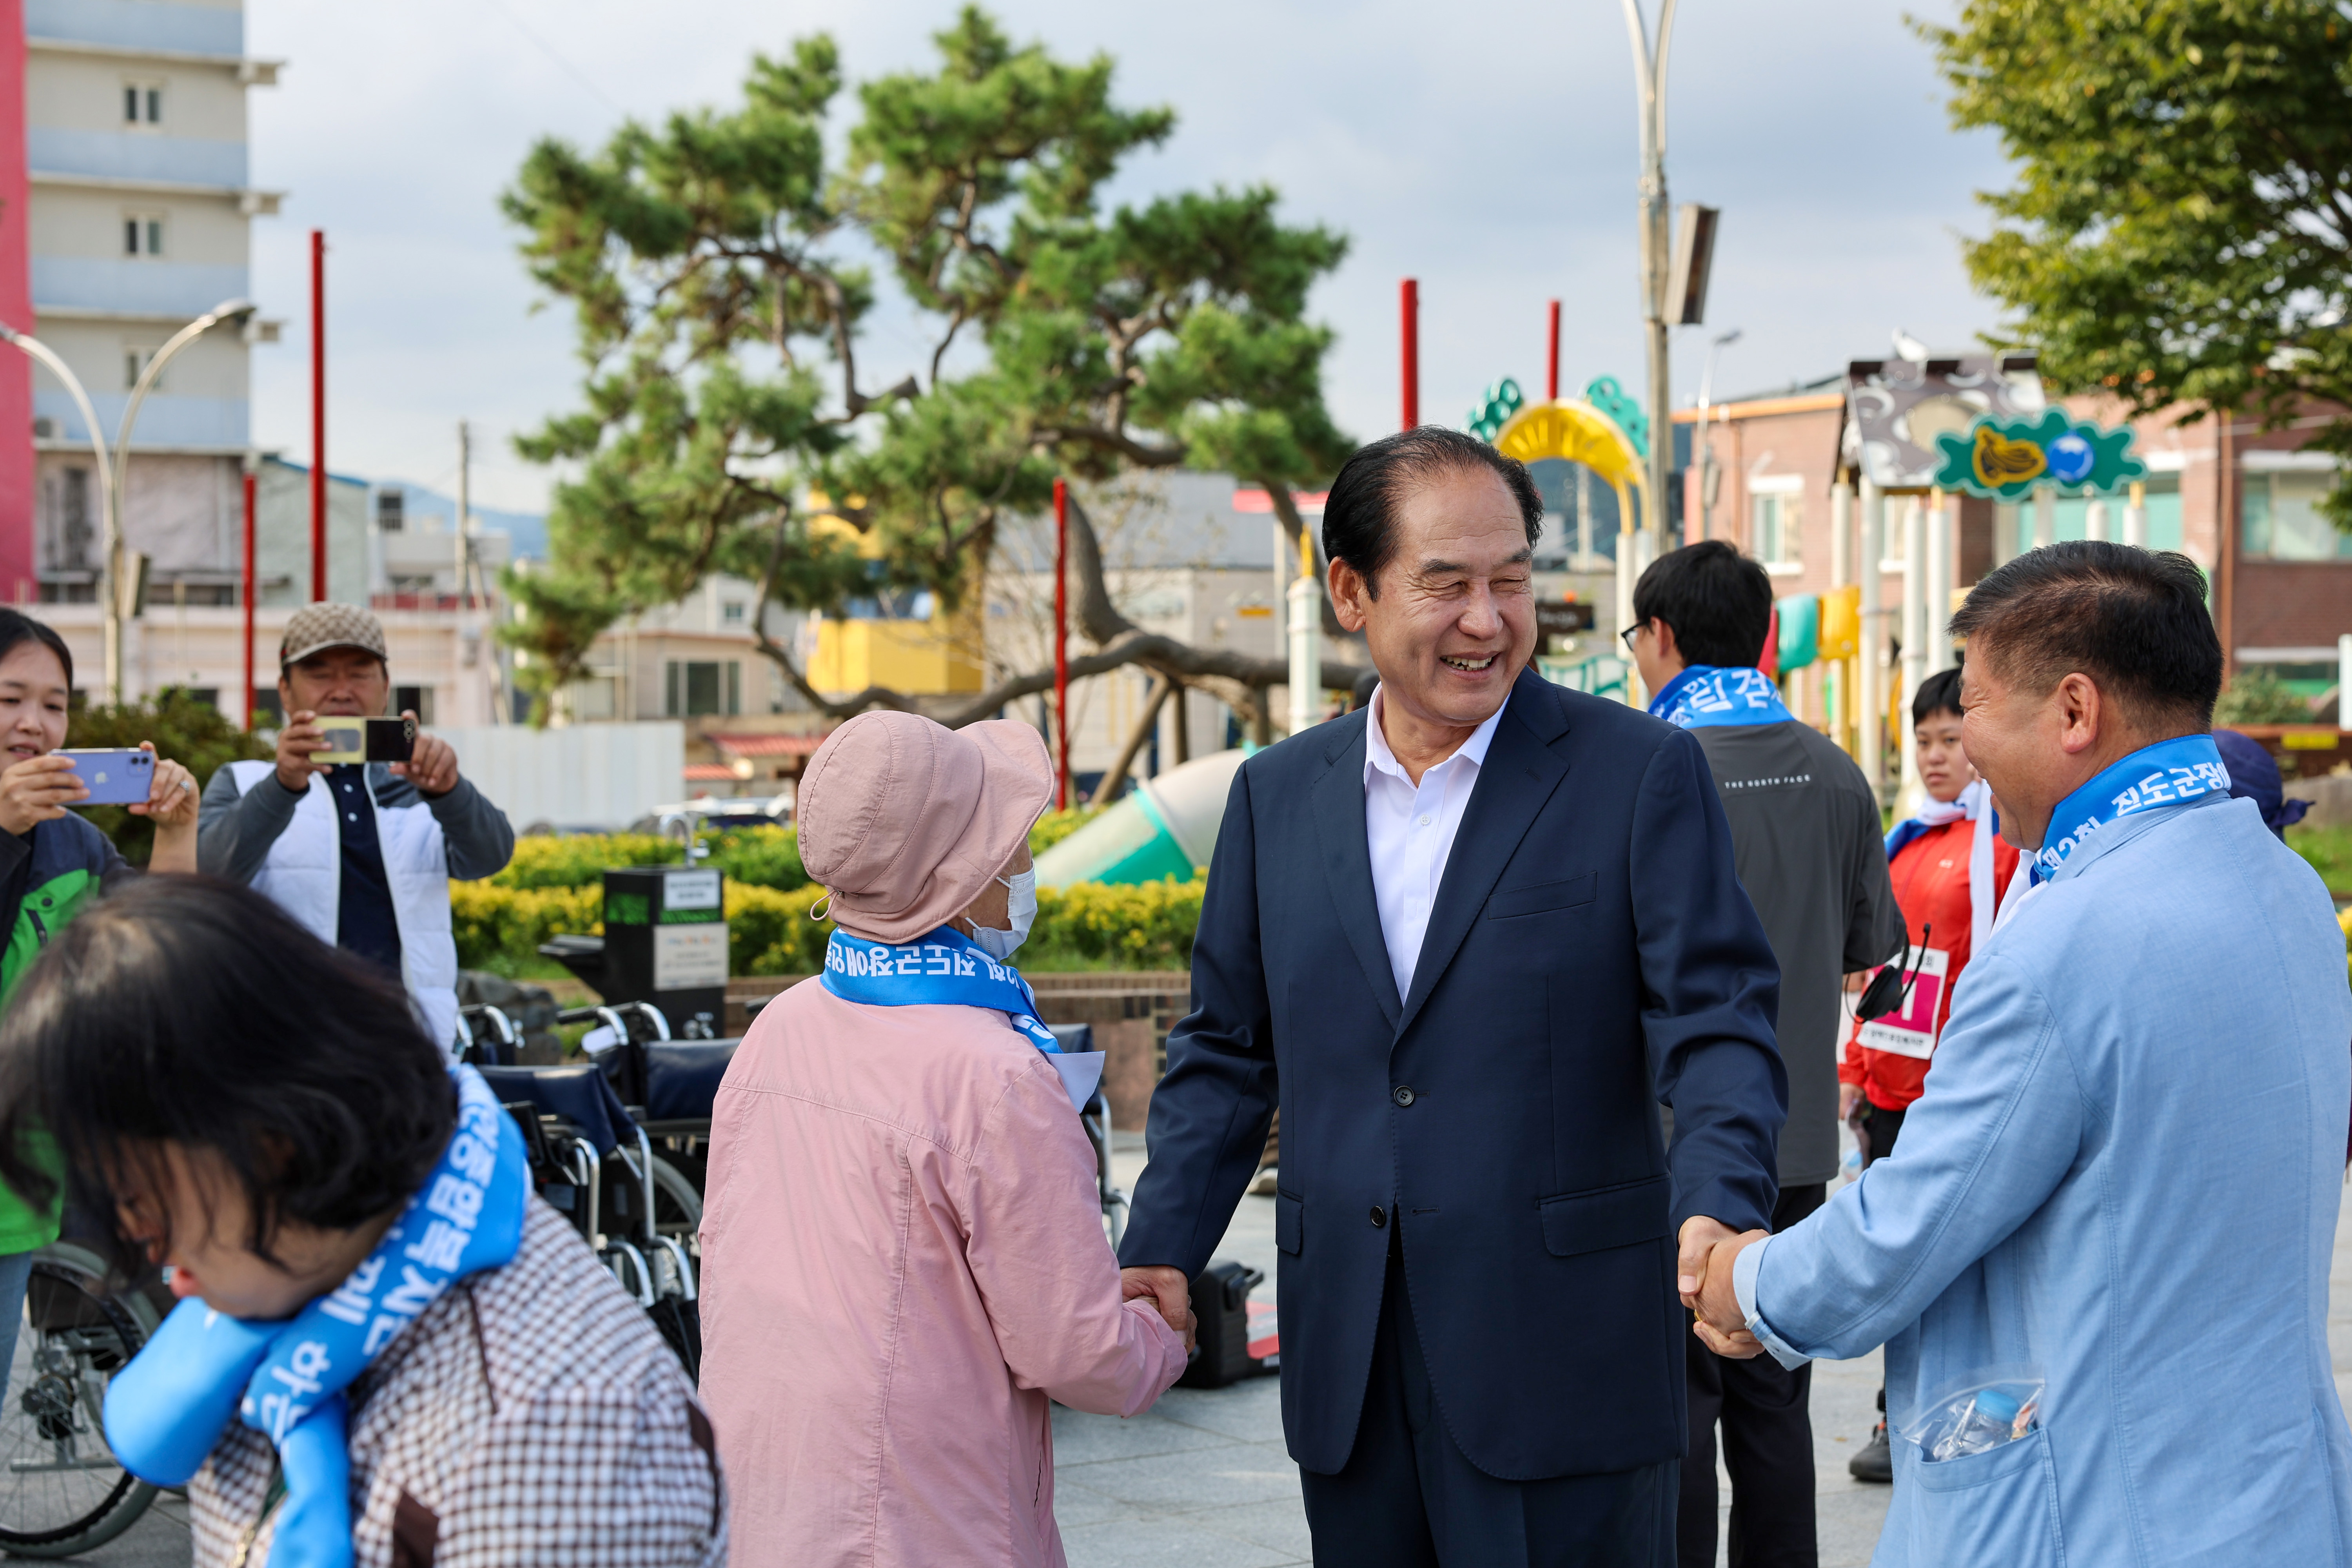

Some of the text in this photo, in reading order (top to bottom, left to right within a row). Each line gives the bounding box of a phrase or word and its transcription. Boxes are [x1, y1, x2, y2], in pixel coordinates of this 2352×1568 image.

[1731, 669, 1783, 708] 걷
[1725, 774, 1811, 789] THE NORTH FACE
[984, 961, 1020, 989] 2회
